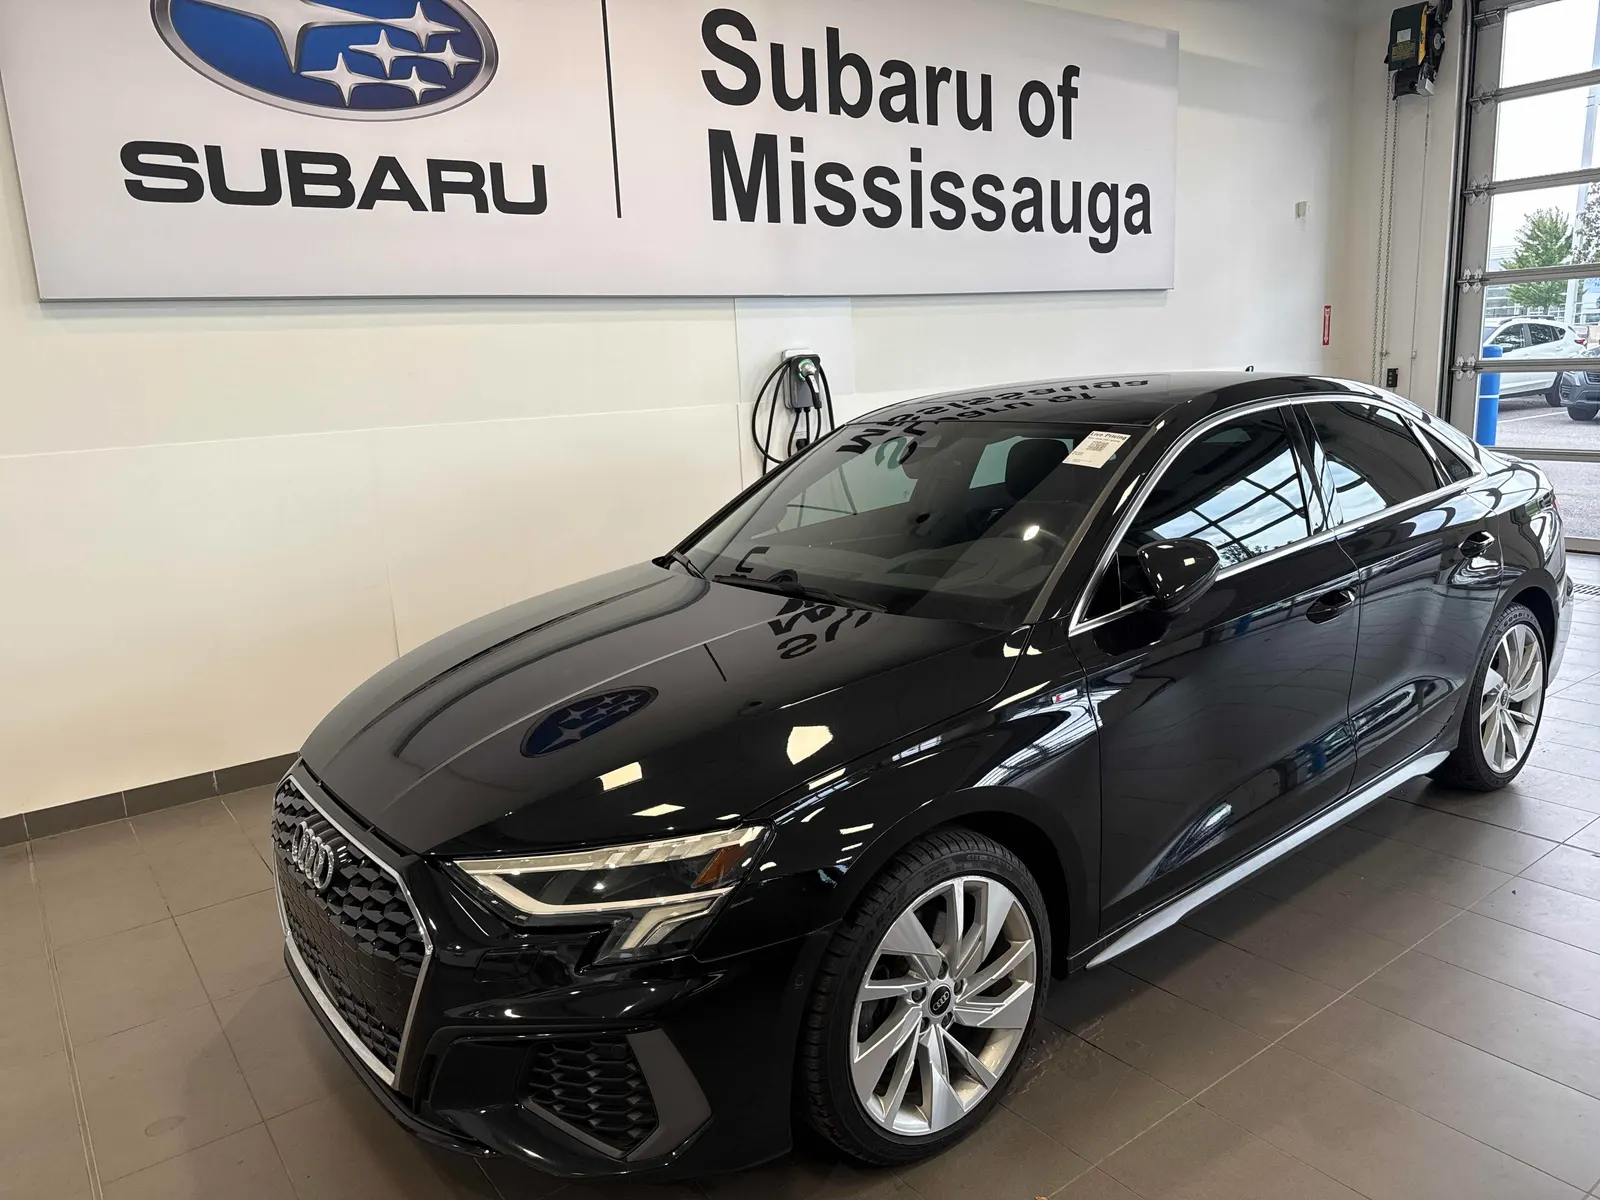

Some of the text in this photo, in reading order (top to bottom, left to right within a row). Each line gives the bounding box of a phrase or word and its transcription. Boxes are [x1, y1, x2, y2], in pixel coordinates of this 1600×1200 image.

[700, 8, 1081, 141] Subaru of
[119, 140, 548, 215] SUBARU
[707, 128, 1152, 254] Mississauga
